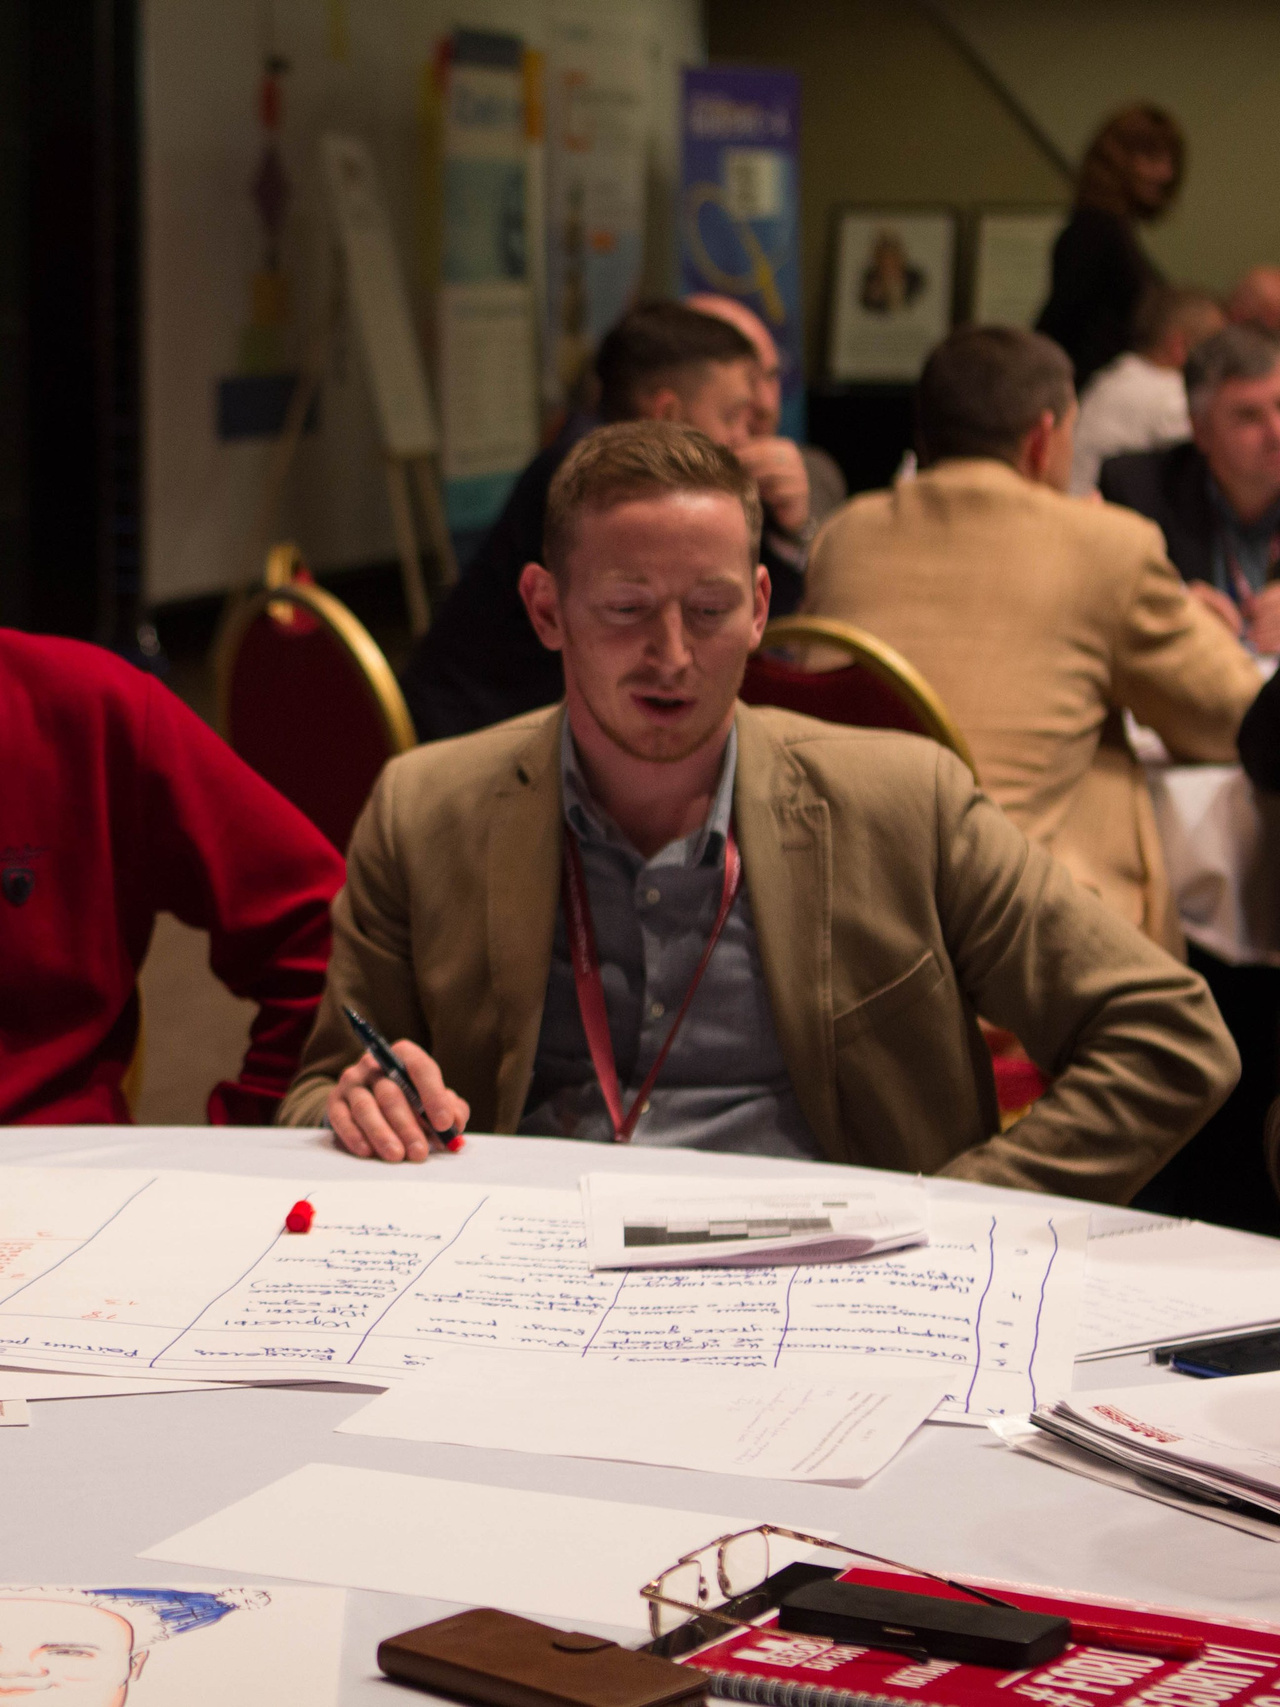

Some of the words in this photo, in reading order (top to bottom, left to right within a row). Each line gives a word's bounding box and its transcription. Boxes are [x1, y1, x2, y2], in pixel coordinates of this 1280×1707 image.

[40, 1340, 139, 1359] Рейтинг
[764, 1642, 825, 1665] БЕЗО
[801, 1644, 870, 1672] БИЗН
[1013, 1646, 1166, 1707] #FORU
[1122, 1648, 1278, 1707] CURITY
